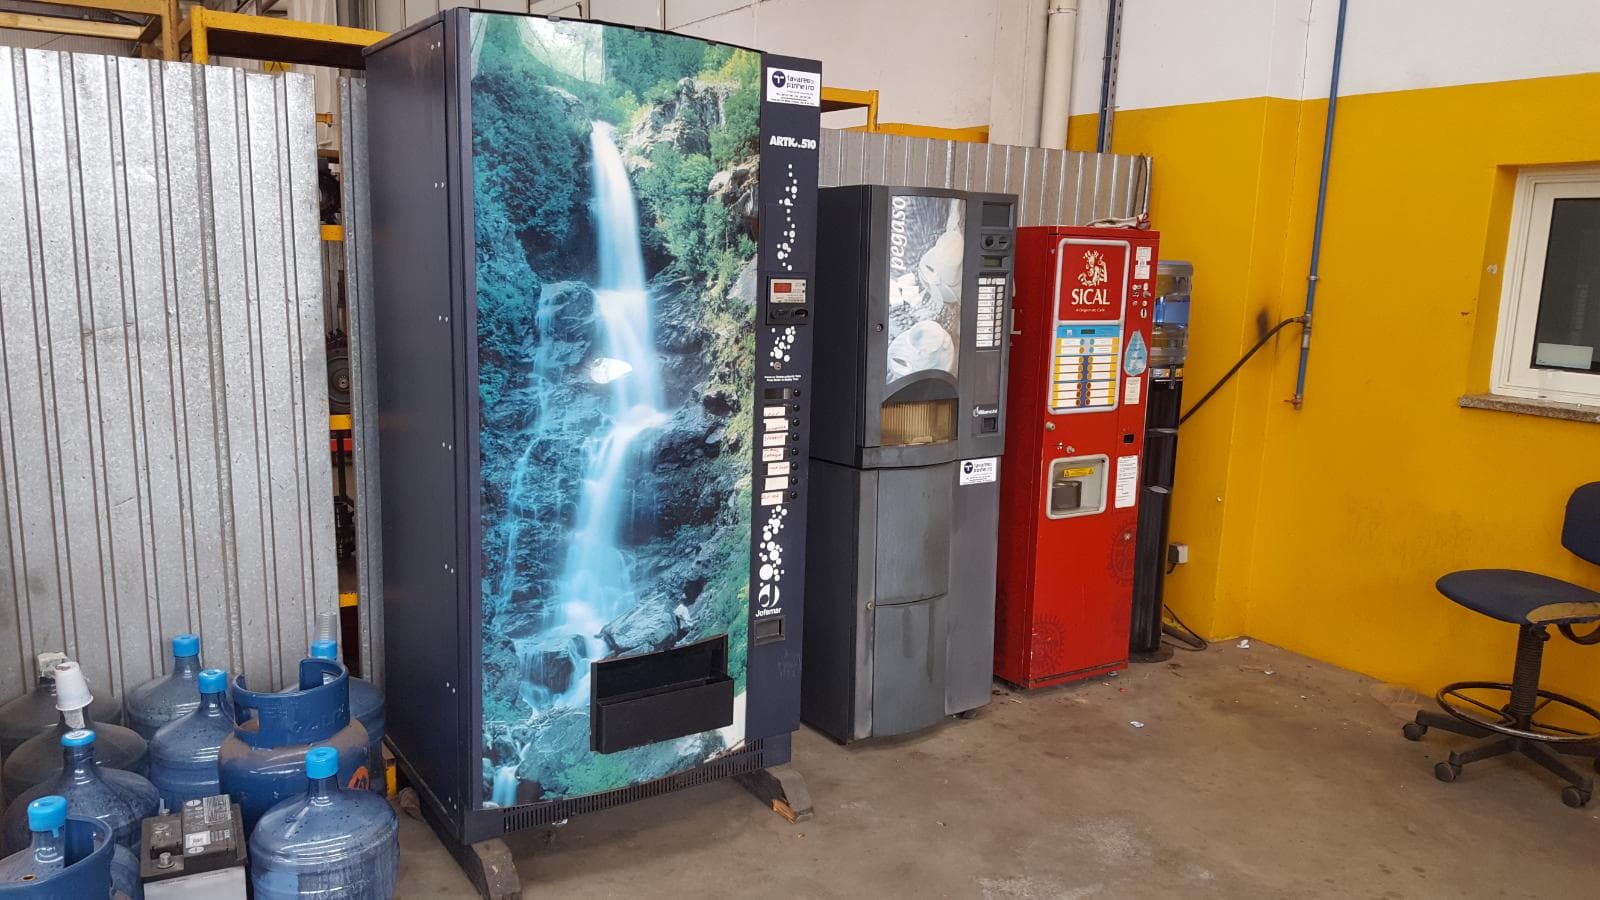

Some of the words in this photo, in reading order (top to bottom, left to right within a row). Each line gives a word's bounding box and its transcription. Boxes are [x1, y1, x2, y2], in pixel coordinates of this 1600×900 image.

[890, 197, 908, 272] pegaso
[1071, 288, 1111, 305] SICAL
[755, 607, 782, 617] Jofemar
